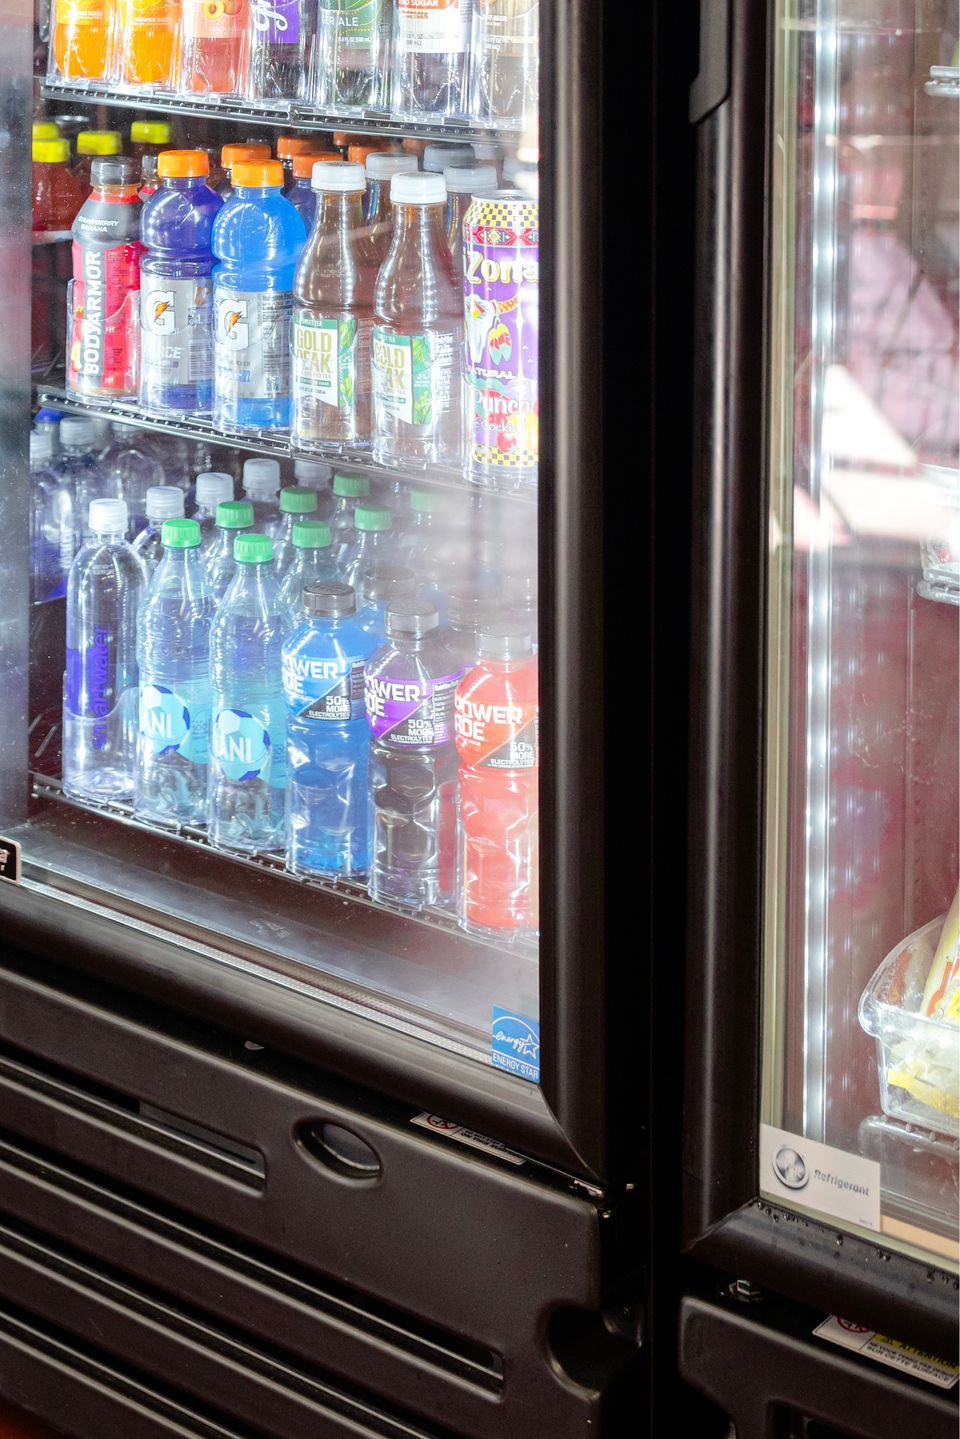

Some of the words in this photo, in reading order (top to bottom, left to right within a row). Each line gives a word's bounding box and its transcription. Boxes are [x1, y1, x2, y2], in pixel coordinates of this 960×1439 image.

[338, 17, 359, 27] ALE
[84, 250, 101, 375] BODYARMOR
[297, 328, 332, 353] GOLD
[492, 1053, 520, 1071] ENERGY
[520, 1064, 539, 1078] STAR
[814, 1168, 871, 1196] Refrigerant
